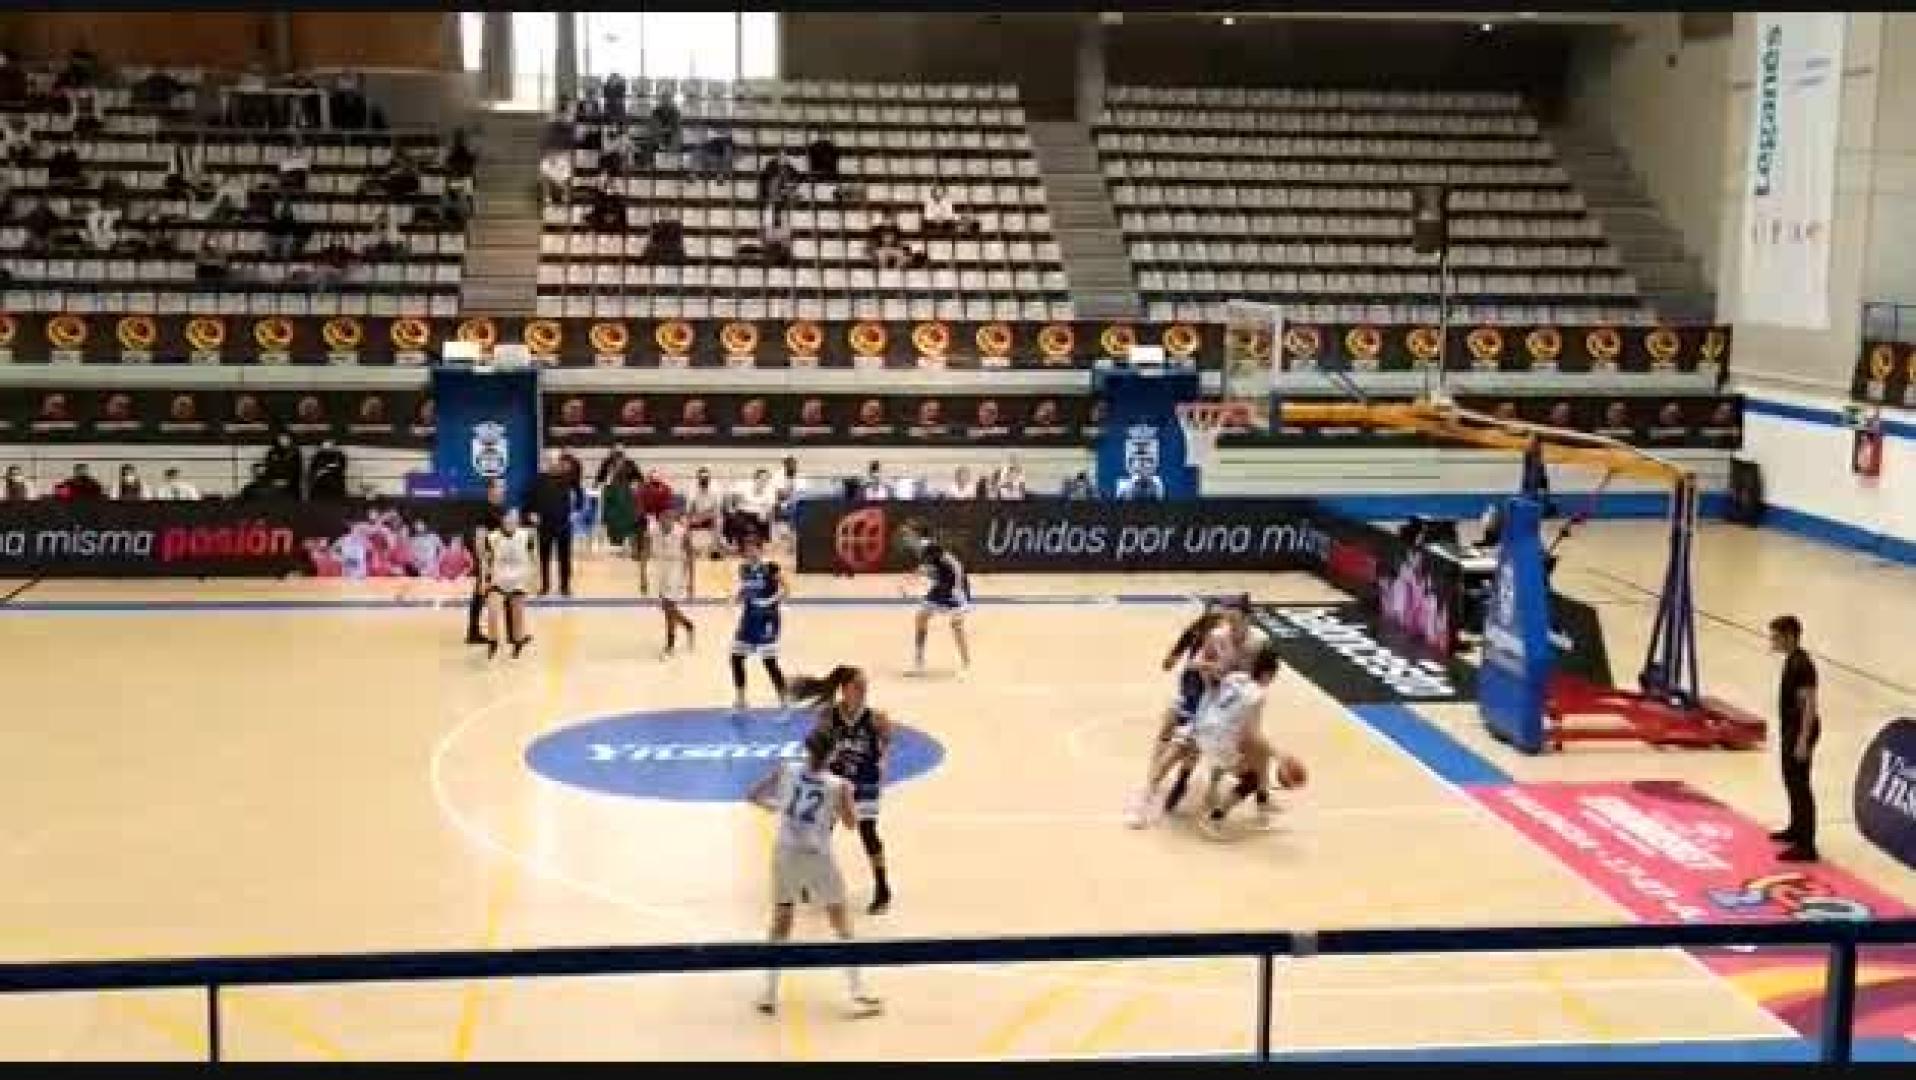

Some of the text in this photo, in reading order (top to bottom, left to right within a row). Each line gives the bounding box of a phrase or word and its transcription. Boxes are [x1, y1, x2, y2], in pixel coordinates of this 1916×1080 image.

[34, 523, 153, 556] misma
[162, 518, 295, 562] pasión
[985, 517, 1107, 555] Unidos
[1115, 524, 1176, 561] por
[1183, 524, 1250, 555] una
[783, 783, 825, 825] 12
